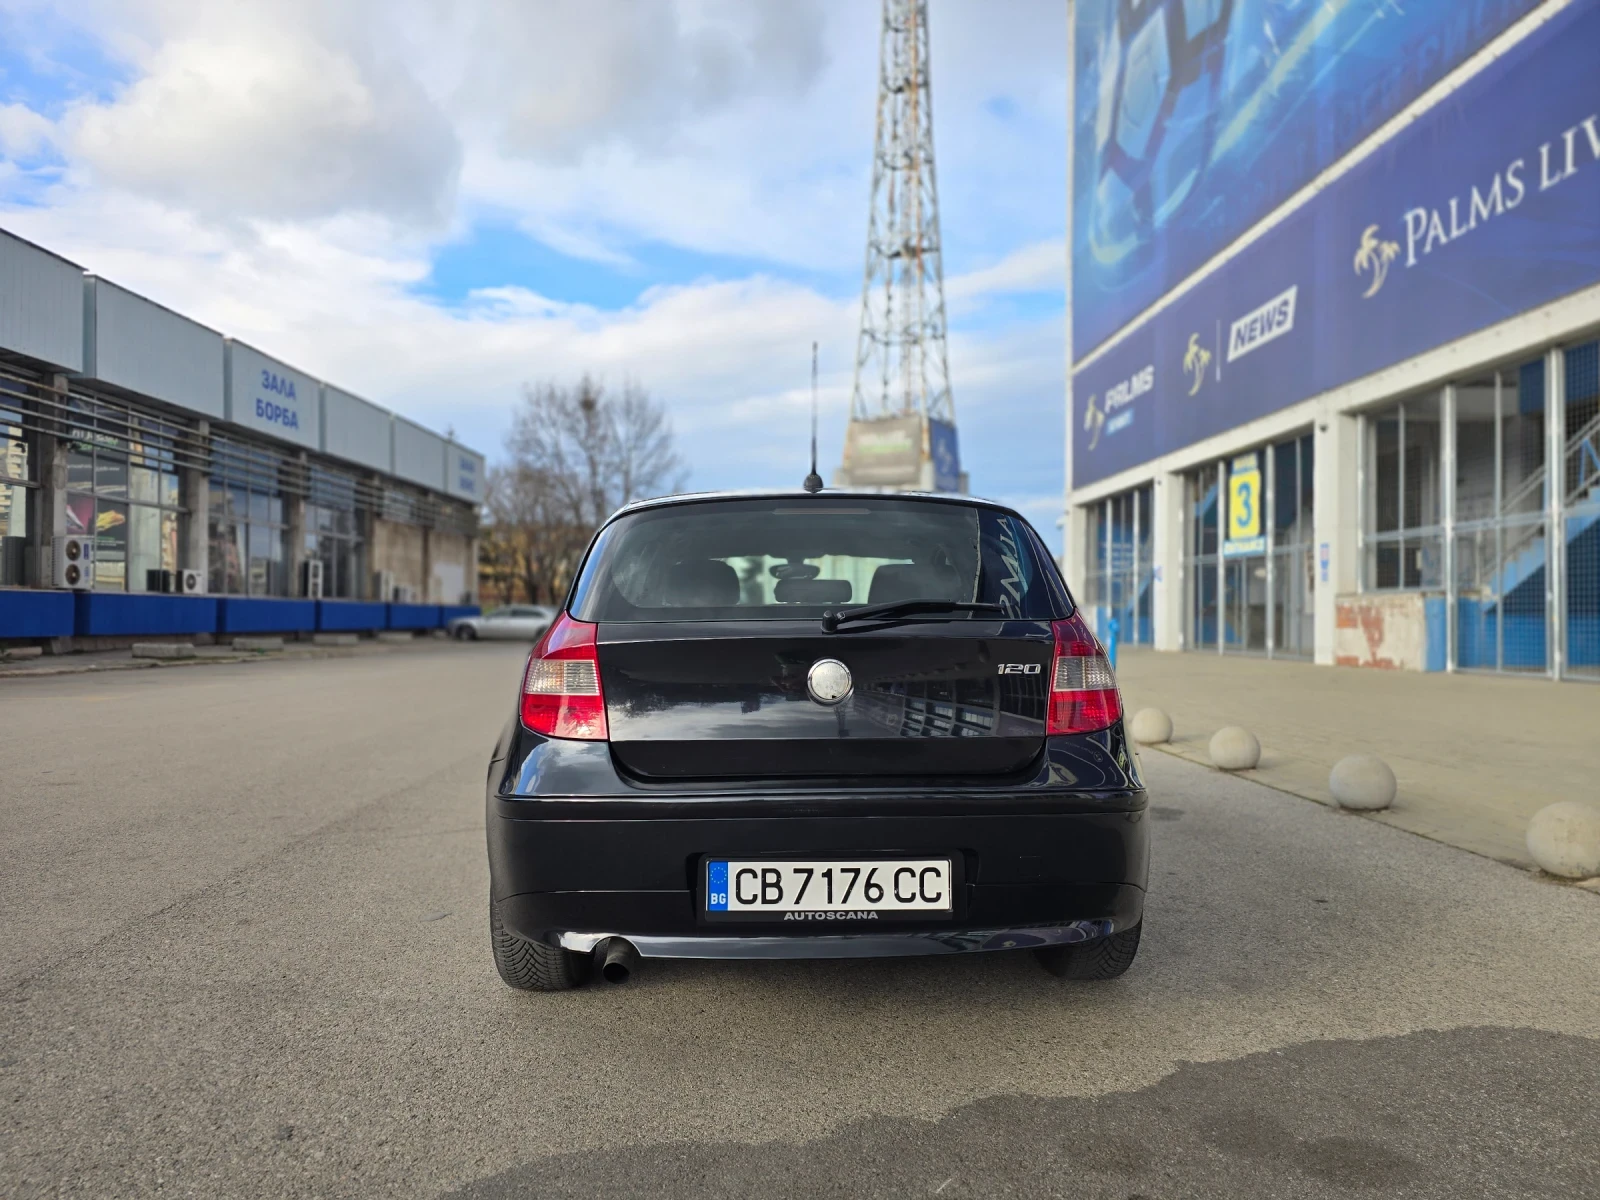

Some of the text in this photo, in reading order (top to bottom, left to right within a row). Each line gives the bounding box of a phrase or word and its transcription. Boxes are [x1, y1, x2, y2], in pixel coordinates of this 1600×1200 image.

[1403, 158, 1525, 268] PALMS
[1234, 298, 1290, 352] NEWS
[261, 369, 296, 402] ЗАЛА
[1104, 364, 1154, 414] PALMS
[256, 397, 299, 430] БОРБА
[1236, 481, 1253, 528] 3
[997, 663, 1041, 675] 120
[710, 867, 942, 905] BG CB 7176 CC
[783, 911, 879, 921] AUTOSCANA
